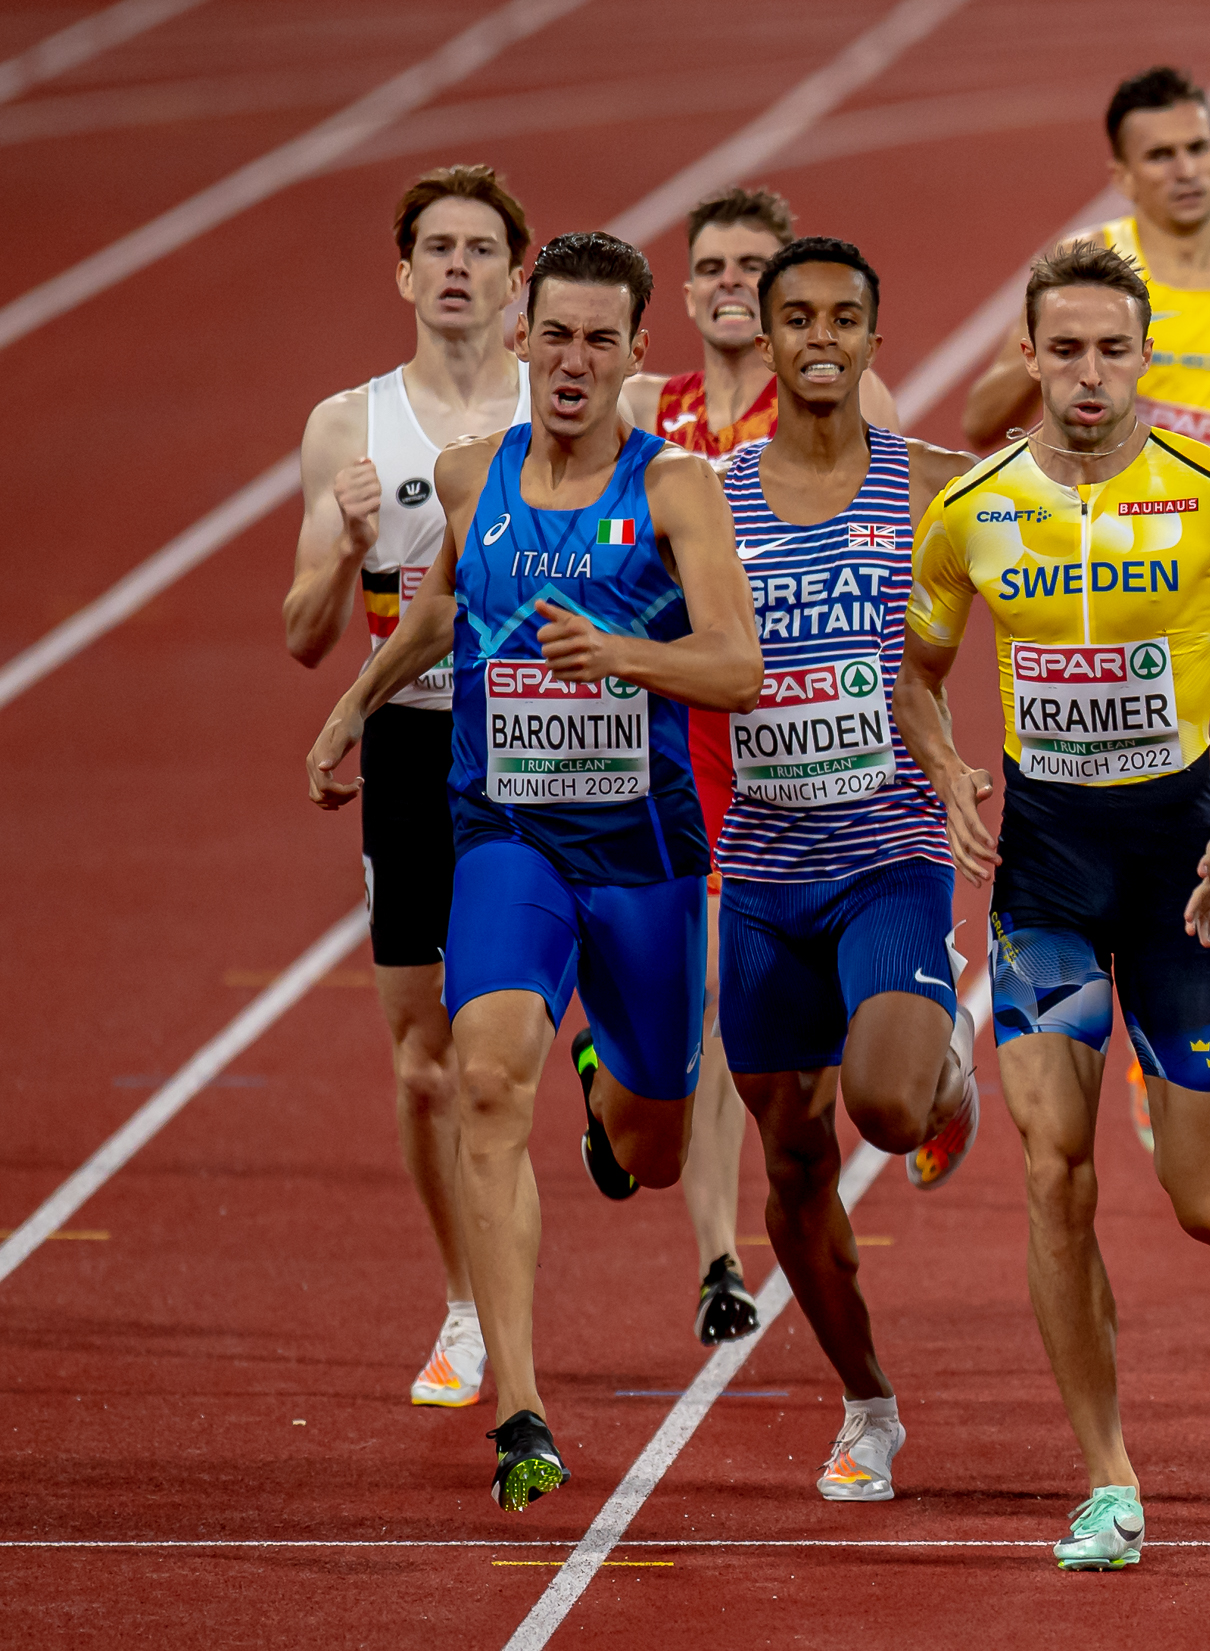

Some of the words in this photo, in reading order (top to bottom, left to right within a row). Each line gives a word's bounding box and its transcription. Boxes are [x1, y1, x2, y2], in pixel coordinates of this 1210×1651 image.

[976, 510, 1036, 523] CRAFT
[1119, 498, 1198, 514] BAUHAUS
[511, 551, 592, 578] ITALIA
[998, 559, 1179, 601] SWEDEN
[754, 602, 885, 640] RITAIN
[1016, 650, 1124, 679] SPAR
[756, 671, 836, 703] PAR
[1019, 693, 1173, 734] KRAMER
[491, 713, 642, 750] BARONTINI
[733, 709, 885, 760] ROWDEN
[1060, 742, 1087, 755] RUN
[1090, 739, 1136, 752] CLEAN
[521, 759, 525, 772] I
[527, 760, 555, 772] RUN
[769, 767, 775, 778] I
[777, 765, 805, 778] RUN
[1030, 754, 1110, 778] MUNICH
[1117, 748, 1173, 773] 2022
[497, 777, 577, 798] MUNICH
[585, 776, 639, 796] 2022
[747, 780, 828, 802] MUNICH
[834, 771, 887, 797] 2022
